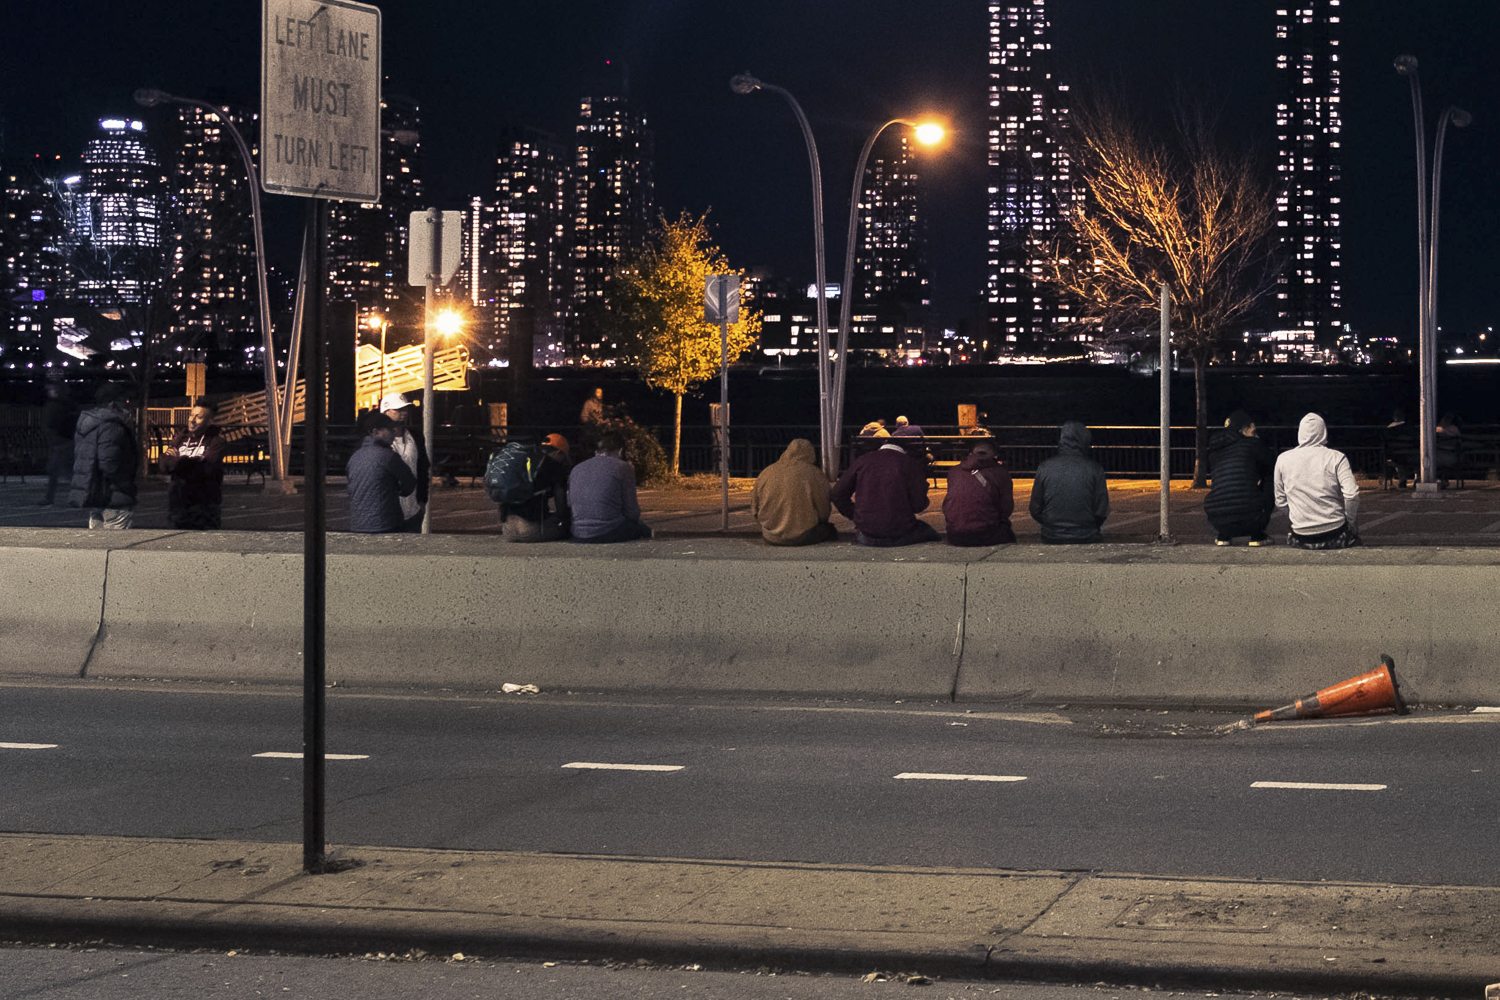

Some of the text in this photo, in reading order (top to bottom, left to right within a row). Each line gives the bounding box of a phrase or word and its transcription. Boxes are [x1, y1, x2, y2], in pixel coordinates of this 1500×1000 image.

[275, 14, 369, 61] LEFT LANE
[293, 74, 350, 117] MUST
[274, 134, 369, 173] TURN LEFT
